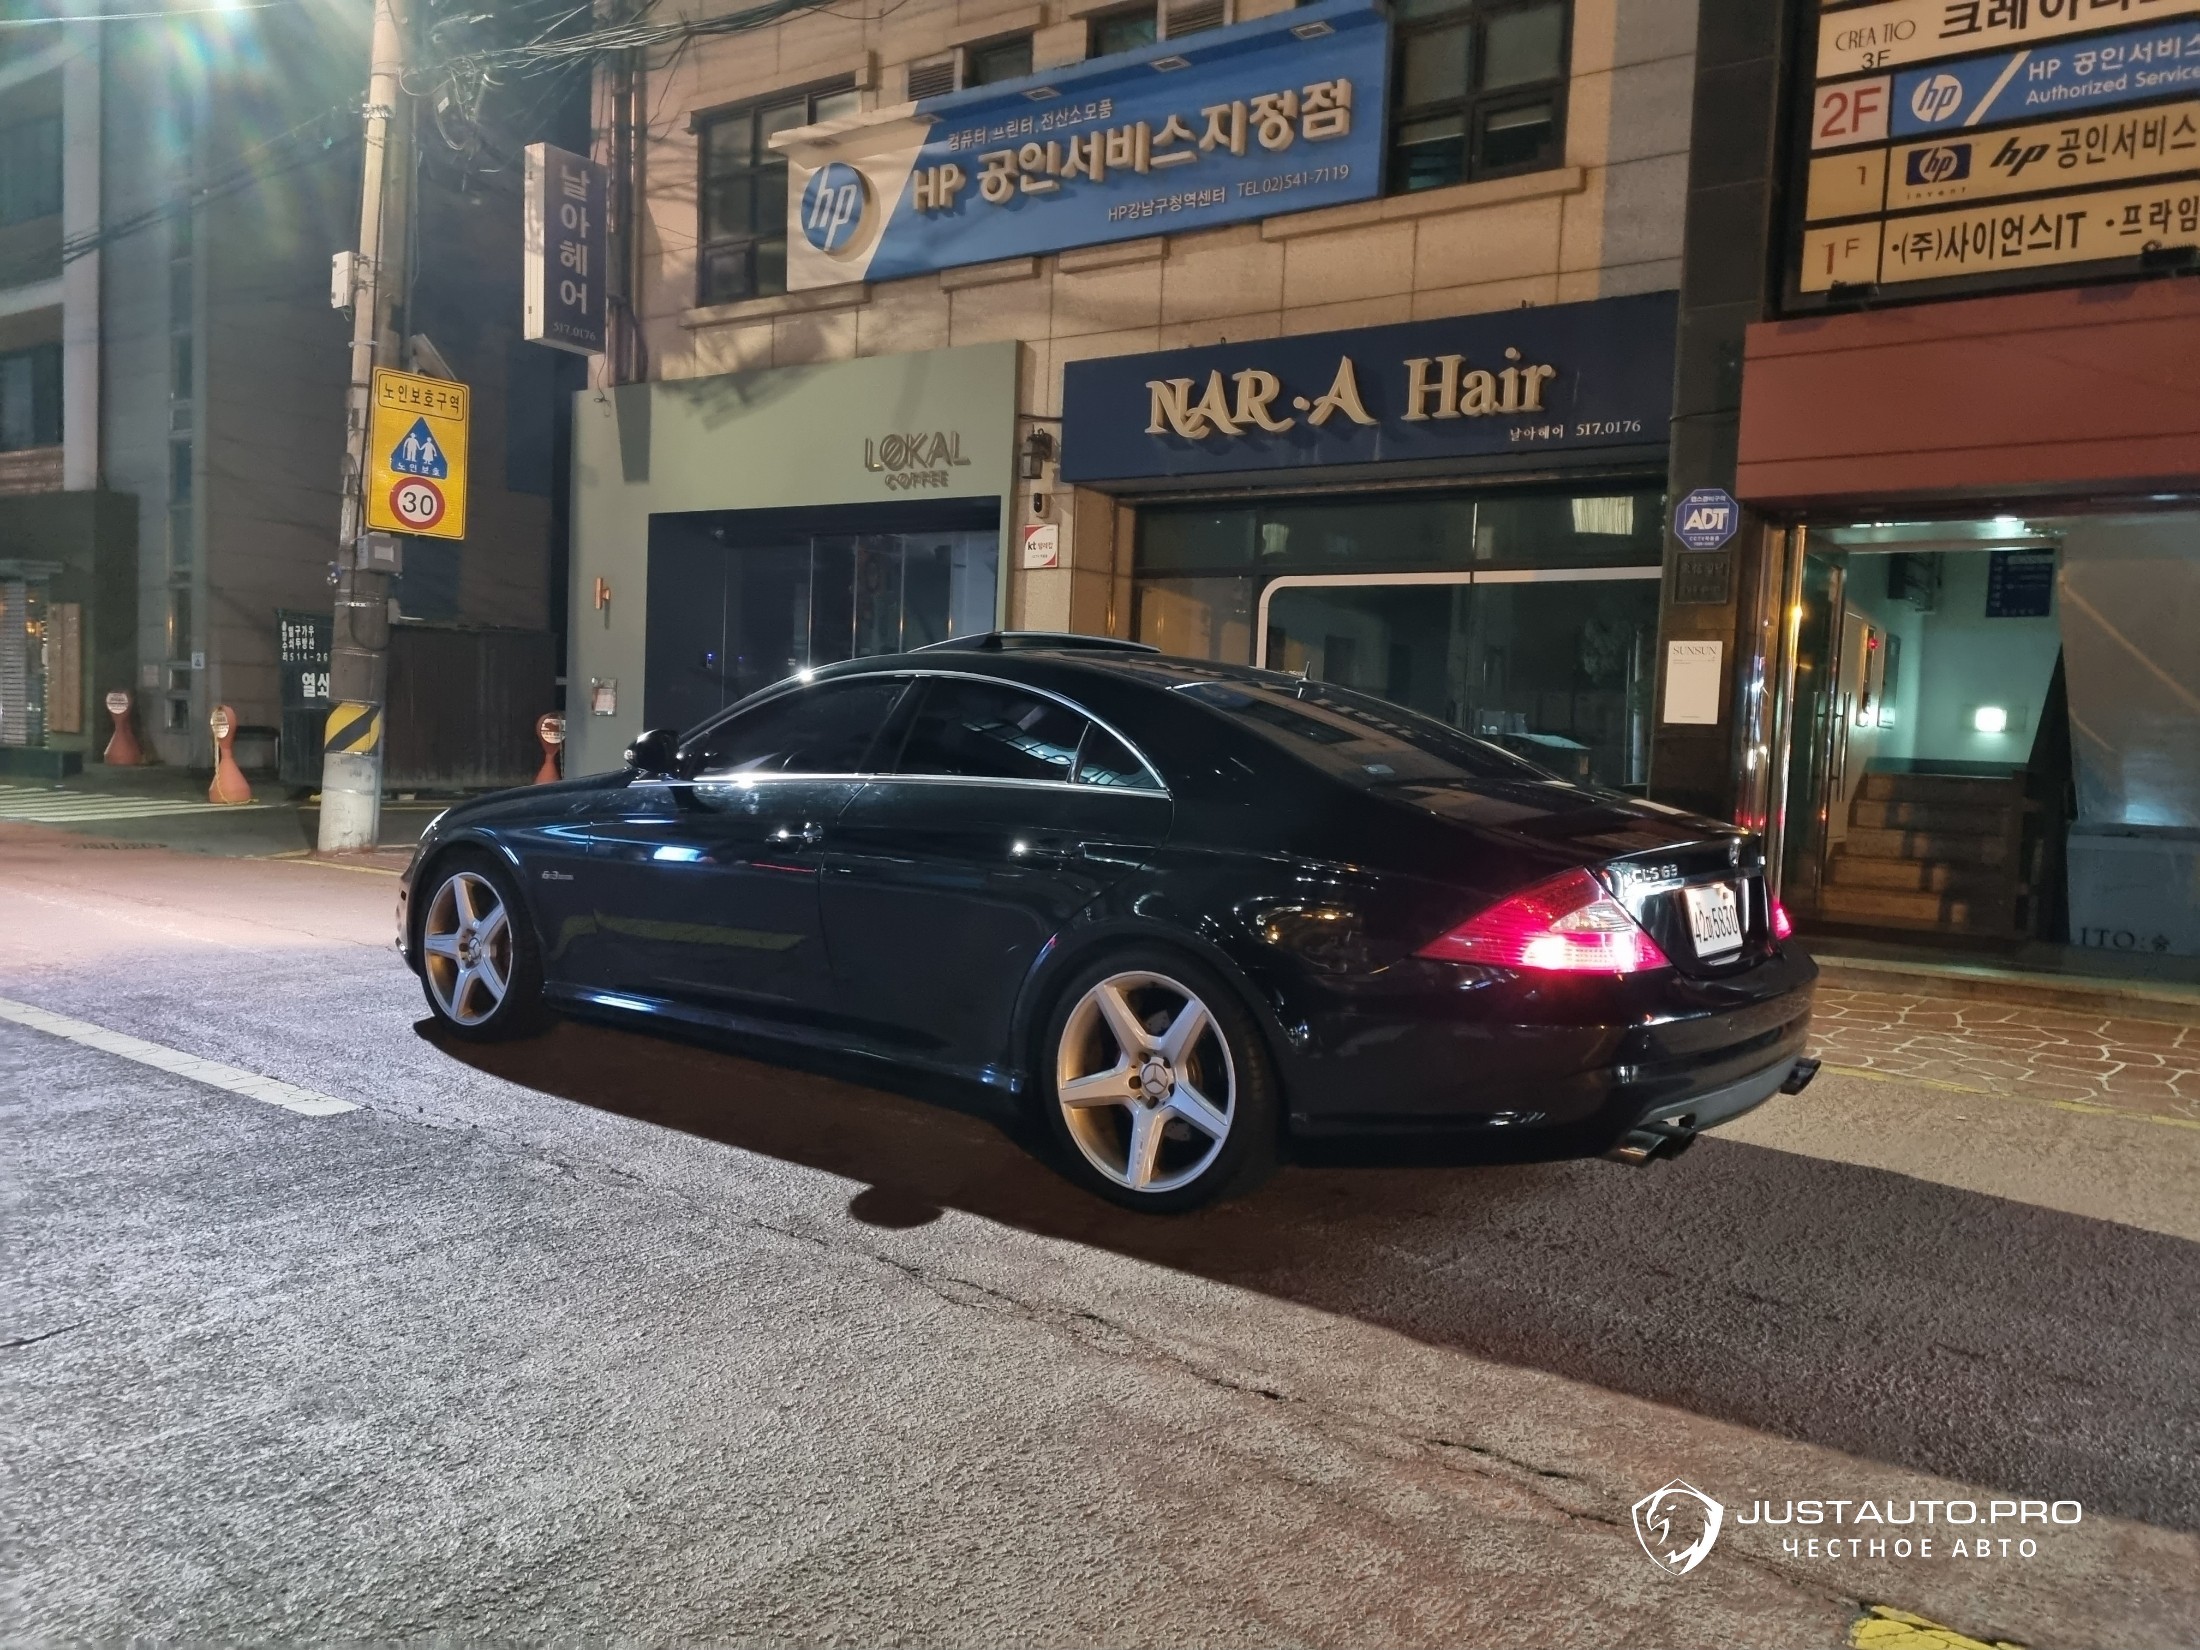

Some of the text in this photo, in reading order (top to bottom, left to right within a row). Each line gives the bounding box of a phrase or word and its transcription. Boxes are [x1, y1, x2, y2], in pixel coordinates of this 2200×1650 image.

[1938, 0, 2165, 39] 크레아
[1861, 49, 1891, 70] 3F
[2029, 59, 2061, 81] HP
[1918, 75, 1958, 122] hp
[2025, 73, 2128, 105] Authorized
[1820, 87, 1882, 138] 2F
[913, 78, 1353, 212] HP 공인서비스지정점
[1989, 114, 2196, 177] hp 공인서비스
[808, 164, 857, 250] hp
[1108, 165, 1349, 222] HP강남구청역센터 TEL 02)541-7119
[559, 164, 590, 315] 날아헤어
[383, 383, 460, 414] 노인보호구역
[1401, 347, 1556, 420] Hair
[1576, 420, 1641, 436] 517.0176
[396, 462, 440, 477] 노인보호
[402, 491, 434, 516] 30
[1684, 508, 1729, 530] ADT
[1027, 542, 1036, 551] kt
[1673, 645, 1717, 656] SUNSUN
